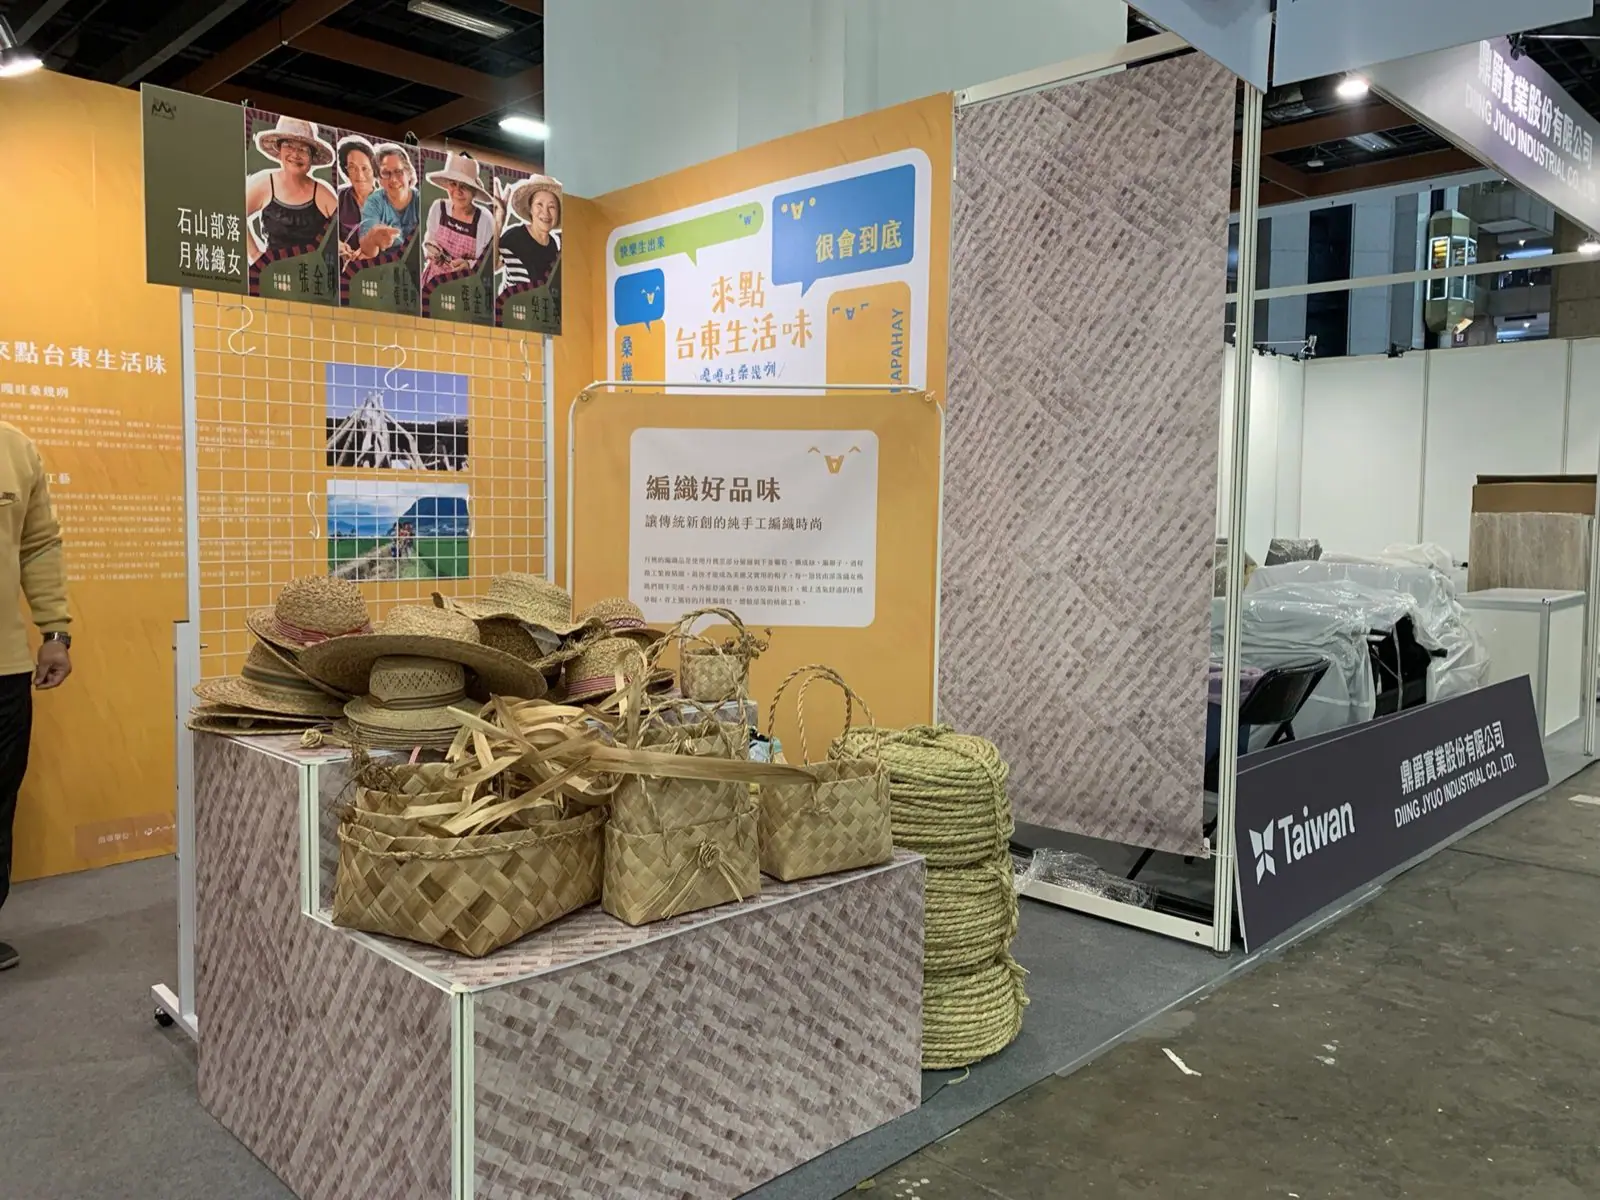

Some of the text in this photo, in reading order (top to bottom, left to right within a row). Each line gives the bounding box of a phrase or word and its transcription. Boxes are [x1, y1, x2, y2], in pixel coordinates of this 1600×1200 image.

[1493, 108, 1516, 146] JYUO
[1517, 129, 1566, 182] INDUSTRIAL
[177, 207, 241, 242] 石山部落
[815, 219, 902, 263] 很會到底
[178, 241, 241, 275] 月桃織女
[619, 236, 665, 259] 快樂生出來
[710, 270, 765, 313] 來點
[675, 309, 814, 361] 台東生活味
[645, 474, 782, 503] 編織好品味
[644, 514, 823, 531] 讓傳統新創的純手工編織時尚
[1399, 720, 1505, 796] 鼎爵實業股份有限公司
[1394, 800, 1421, 828] DIING
[1421, 788, 1443, 816] JYUO
[1443, 771, 1486, 803] INDUSTRIAL
[1277, 802, 1356, 864] Taiwan
